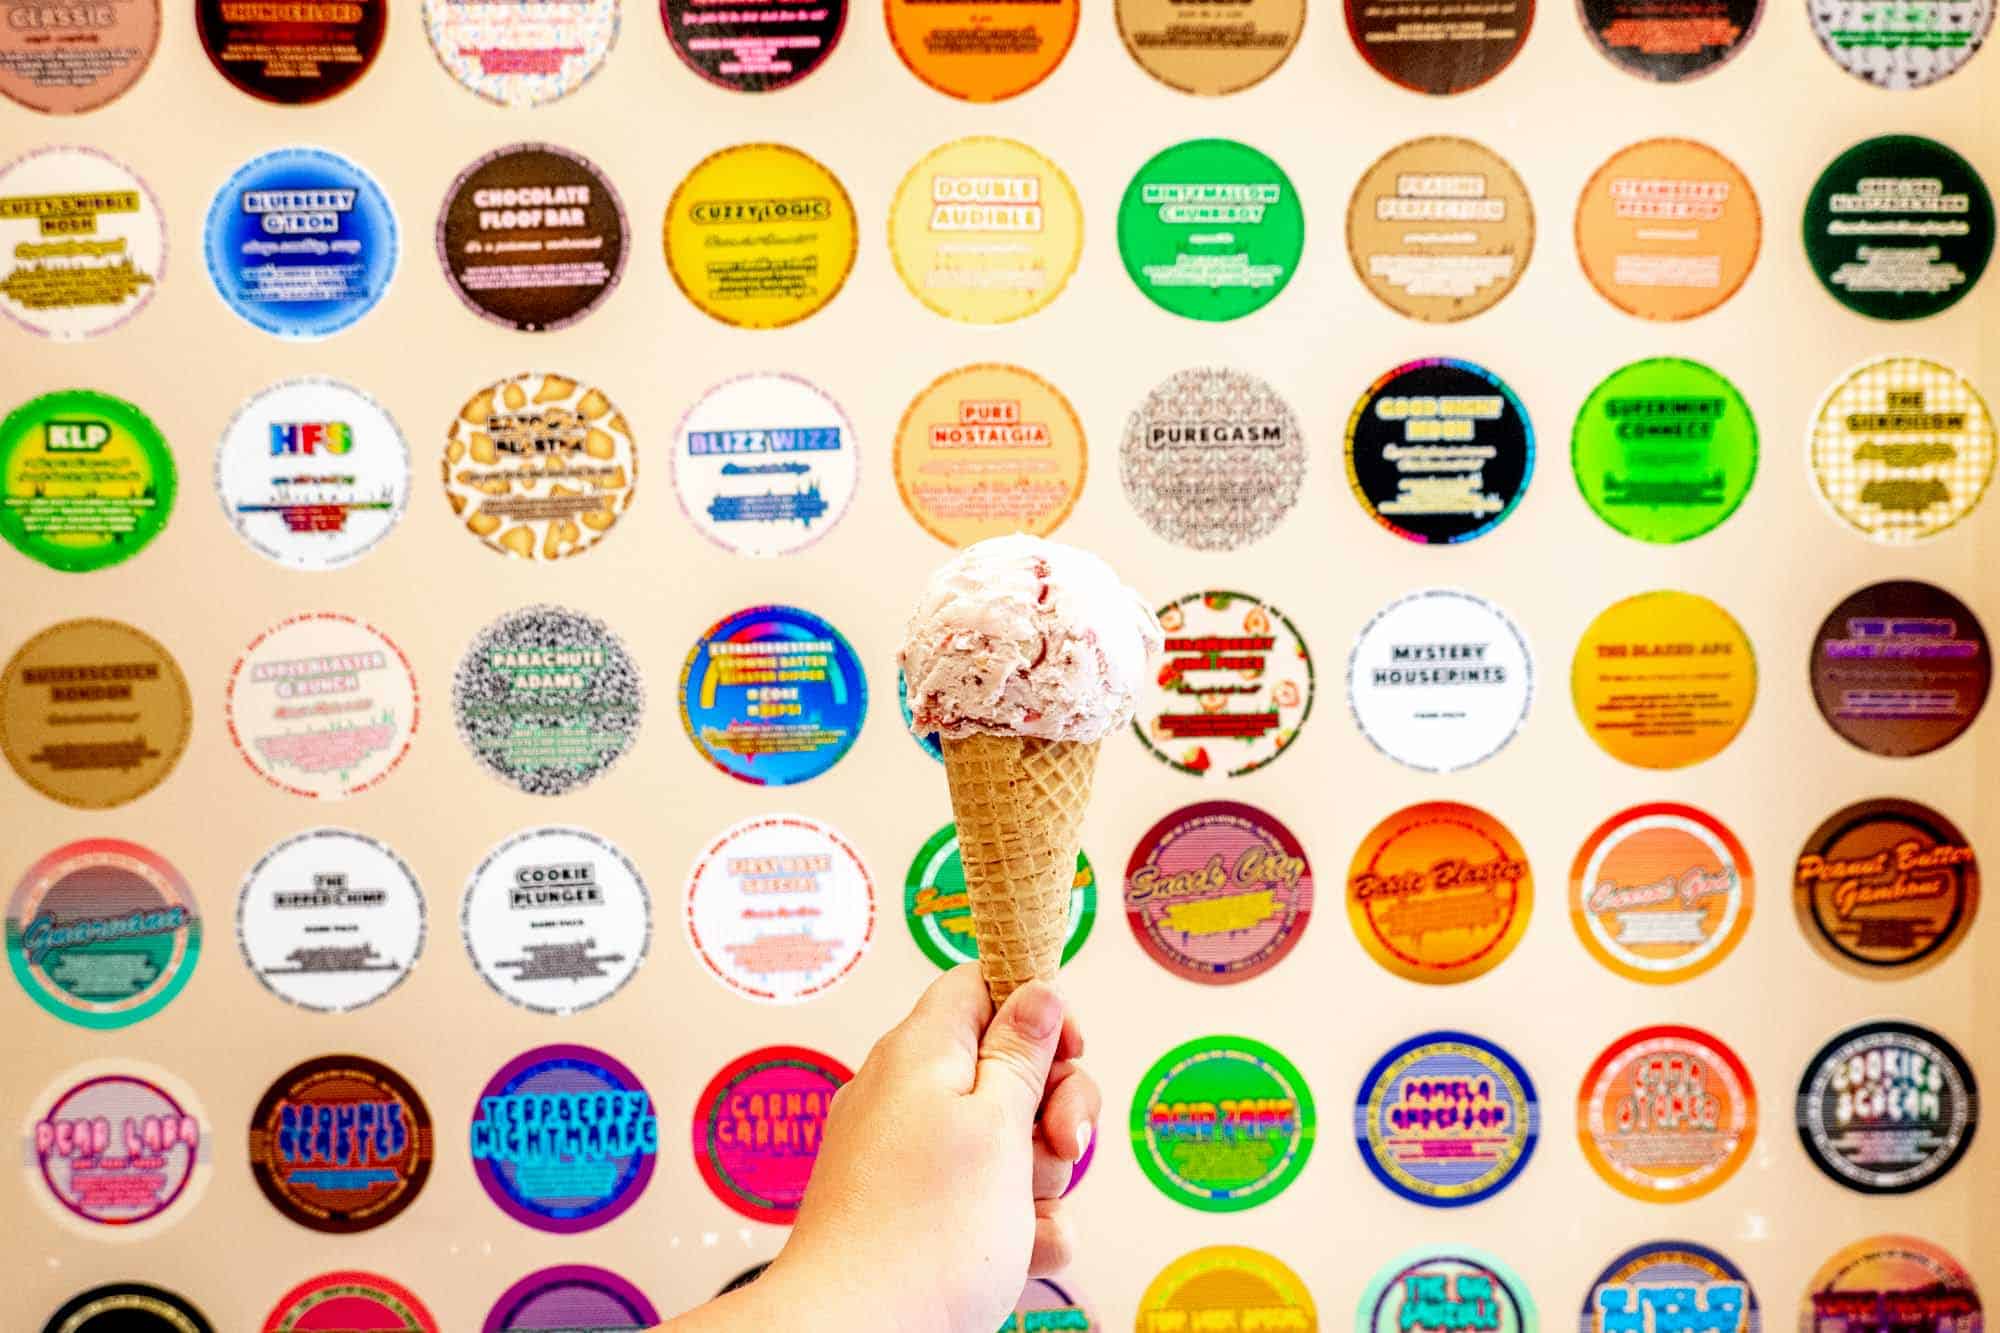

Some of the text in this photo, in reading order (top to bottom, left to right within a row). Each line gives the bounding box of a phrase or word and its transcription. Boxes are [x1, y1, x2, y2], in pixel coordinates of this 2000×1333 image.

[473, 186, 588, 208] CHOCOLATE
[936, 181, 1033, 199] DOUBLE
[246, 193, 354, 210] BLUEBERRY
[544, 208, 583, 228] BAR
[934, 207, 1032, 227] AUDIBLE
[1889, 393, 1922, 409] THE
[963, 405, 1015, 420] PURE
[49, 422, 109, 450] KLP
[269, 422, 353, 455] HFS
[690, 429, 839, 453] BLIZZ WIZZ
[933, 427, 1046, 443] NOSTALGIA
[1149, 426, 1279, 443] PUREGASM
[491, 650, 604, 668] PARACHUTE
[1392, 646, 1486, 660] MYSTERY
[514, 674, 581, 690] ADAMS
[1374, 668, 1505, 685] HOUSE PINTS
[1799, 841, 1974, 881] Peanut Butter
[315, 875, 345, 887] THE
[518, 867, 590, 883] COOKIE
[1129, 844, 1306, 901] Snack City
[1352, 872, 1424, 901] Basic
[513, 888, 598, 905] PLUNGER
[1831, 1050, 1943, 1094] COOKIES
[1403, 1080, 1491, 1105] PAMELA
[1390, 1106, 1507, 1131] ANDERSON
